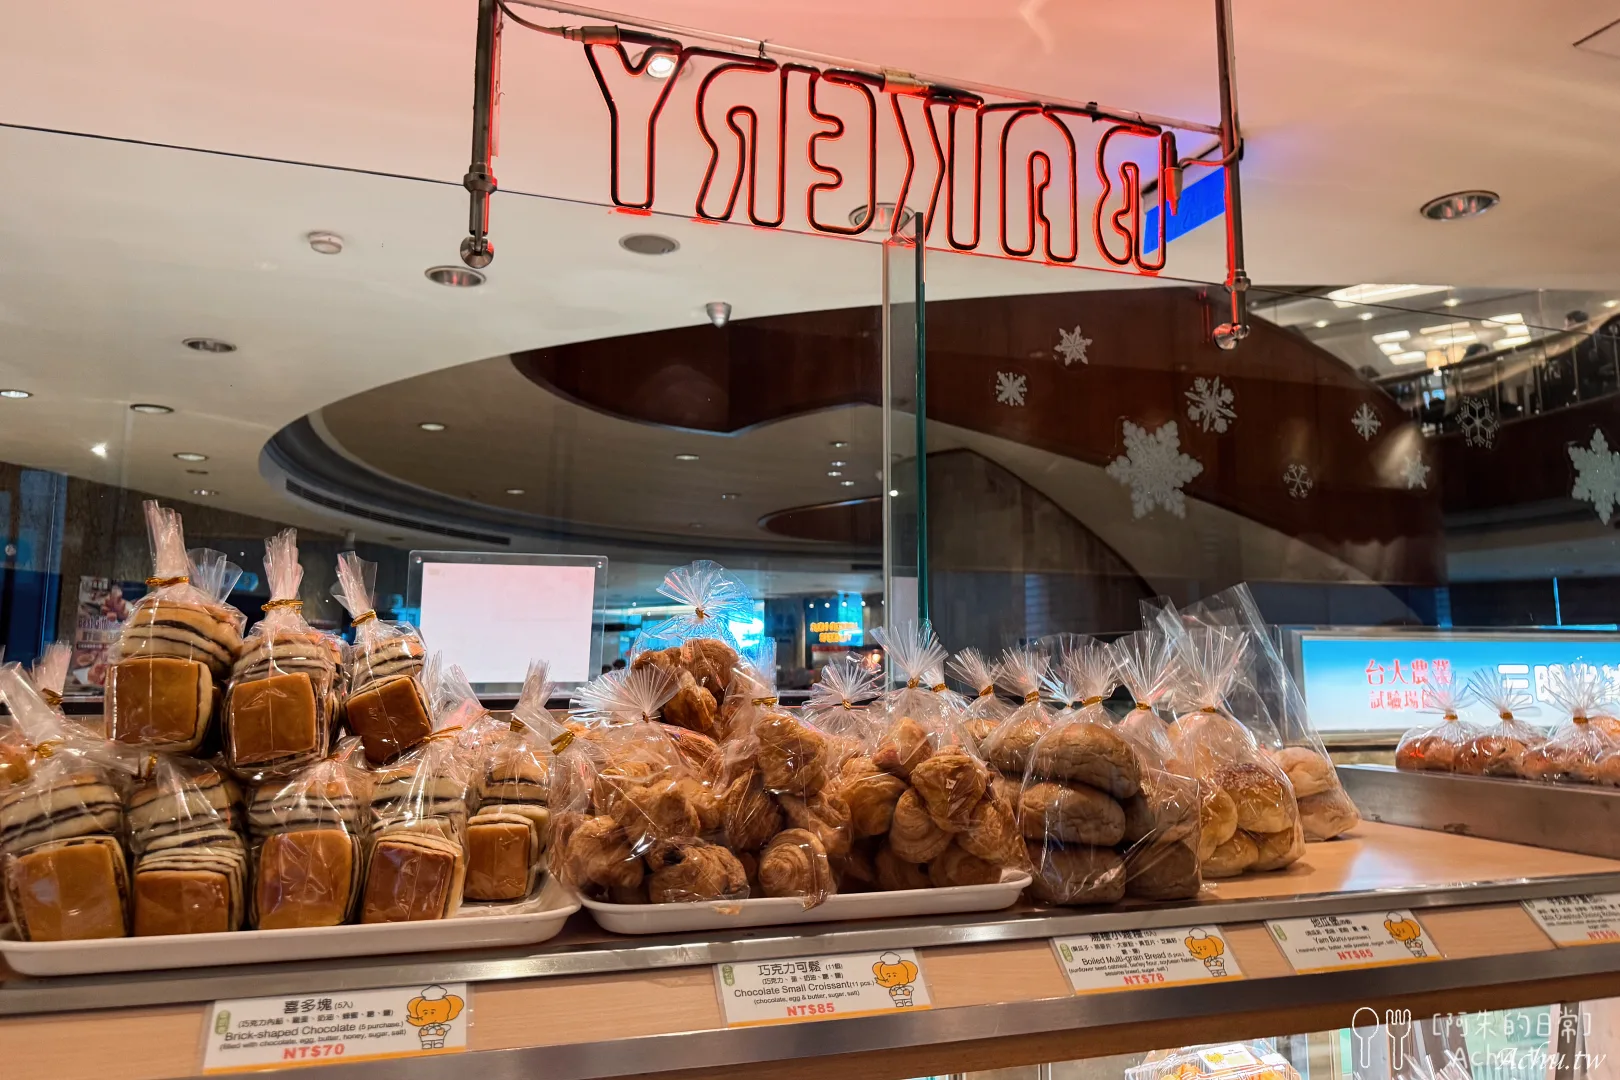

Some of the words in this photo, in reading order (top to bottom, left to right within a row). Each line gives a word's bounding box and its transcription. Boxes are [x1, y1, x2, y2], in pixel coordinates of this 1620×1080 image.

[1082, 956, 1105, 965] Boiled
[1144, 951, 1166, 959] Bread
[758, 960, 821, 976] 巧克力可鬆
[1124, 973, 1164, 985] NT$78
[734, 986, 780, 998] Chocolate
[781, 984, 806, 993] Small
[284, 998, 332, 1014] 喜多塊
[787, 1002, 835, 1016] NT$85
[225, 1027, 298, 1042] Brick-shaped
[302, 1023, 356, 1035] Chocolate
[283, 1043, 345, 1059] NT$70
